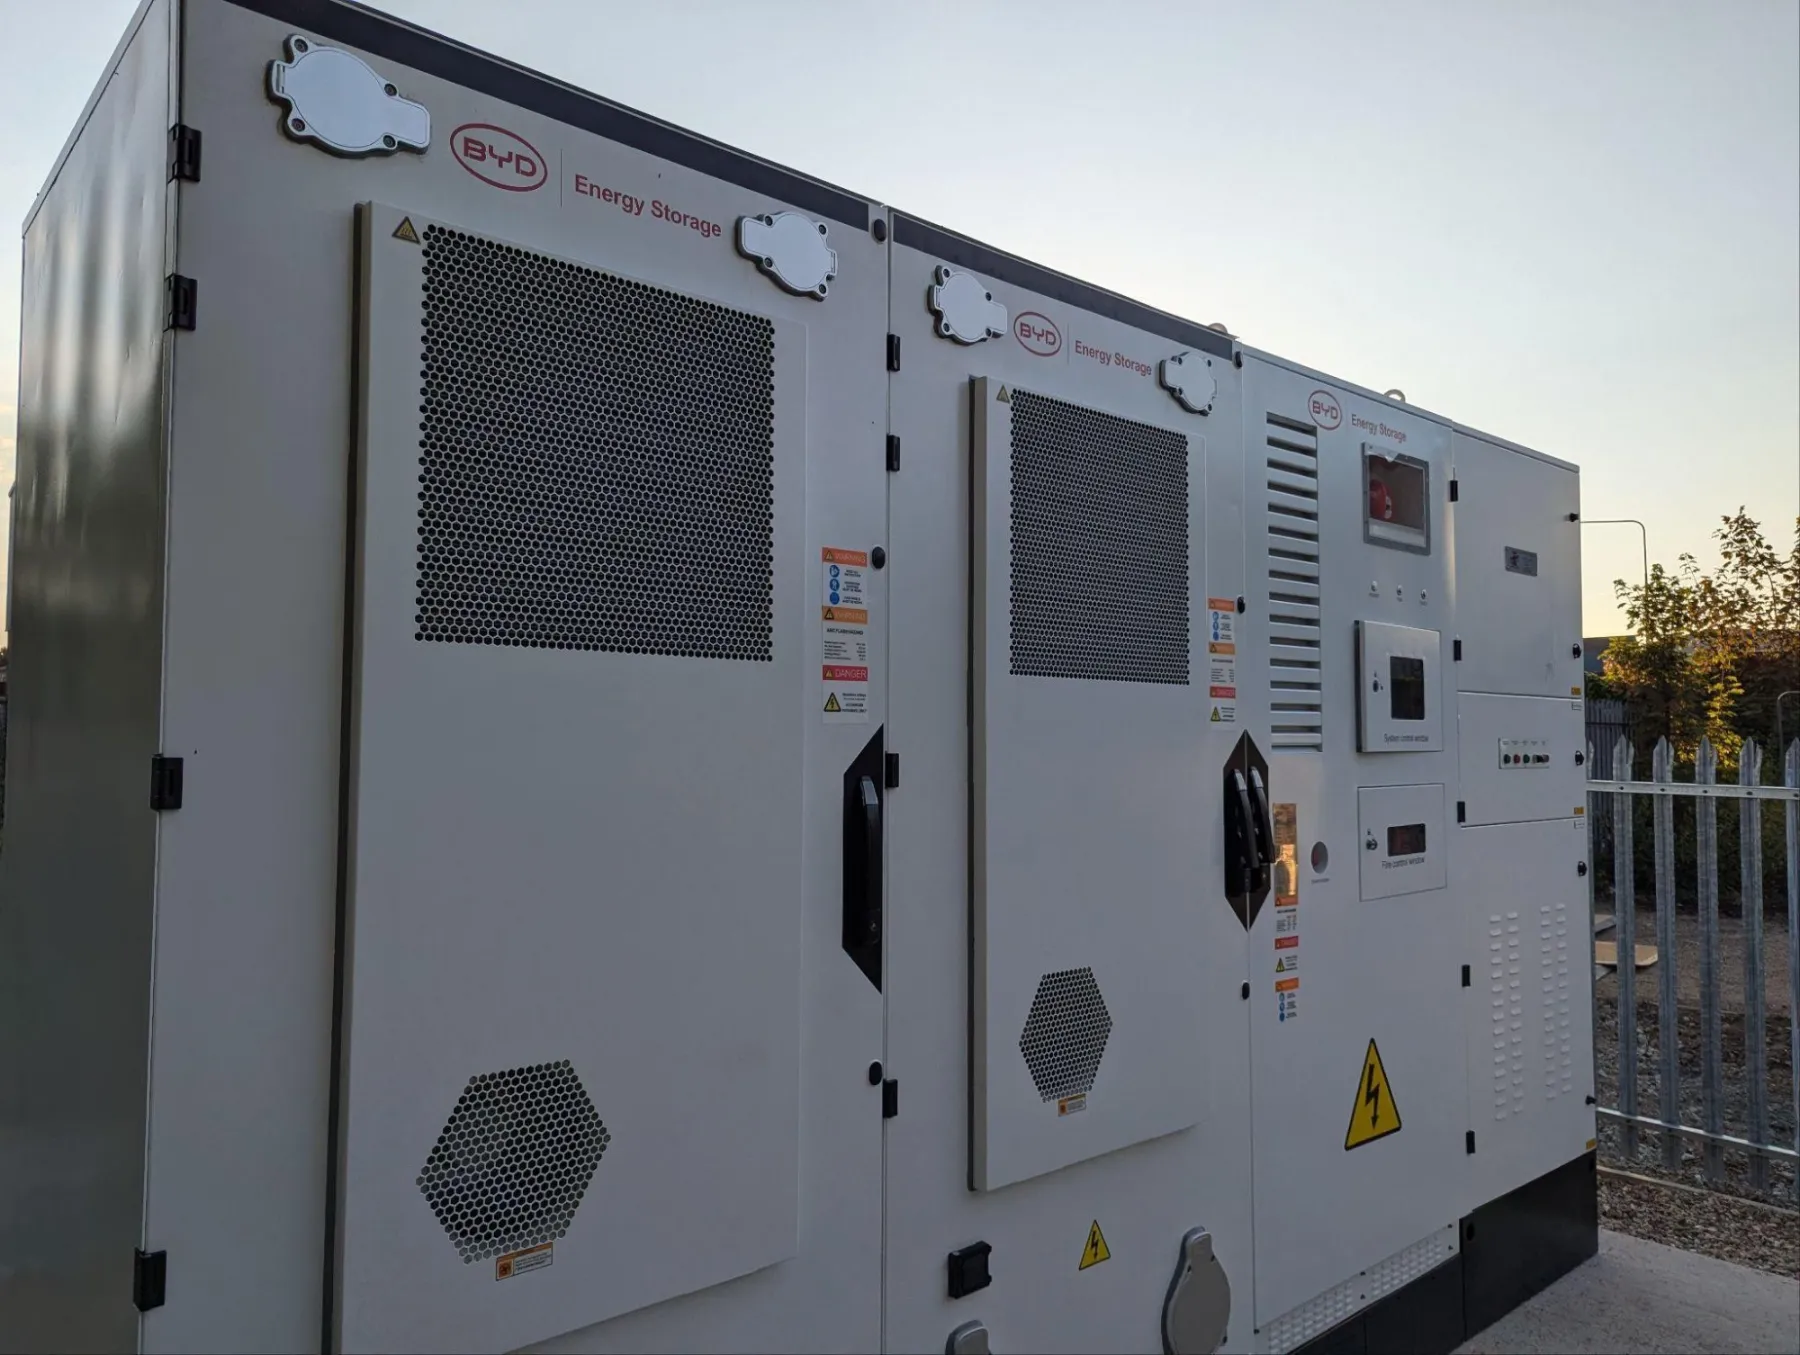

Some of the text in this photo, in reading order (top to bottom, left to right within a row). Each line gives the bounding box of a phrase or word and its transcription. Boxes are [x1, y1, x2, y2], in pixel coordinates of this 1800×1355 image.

[463, 136, 537, 177] BYD
[574, 174, 722, 238] Energy Storage
[1019, 322, 1057, 346] BYD
[1075, 340, 1152, 377] Energy Storage
[1312, 400, 1339, 420] BYD
[1351, 413, 1407, 444] Energy Storage
[835, 668, 867, 679] DANGER
